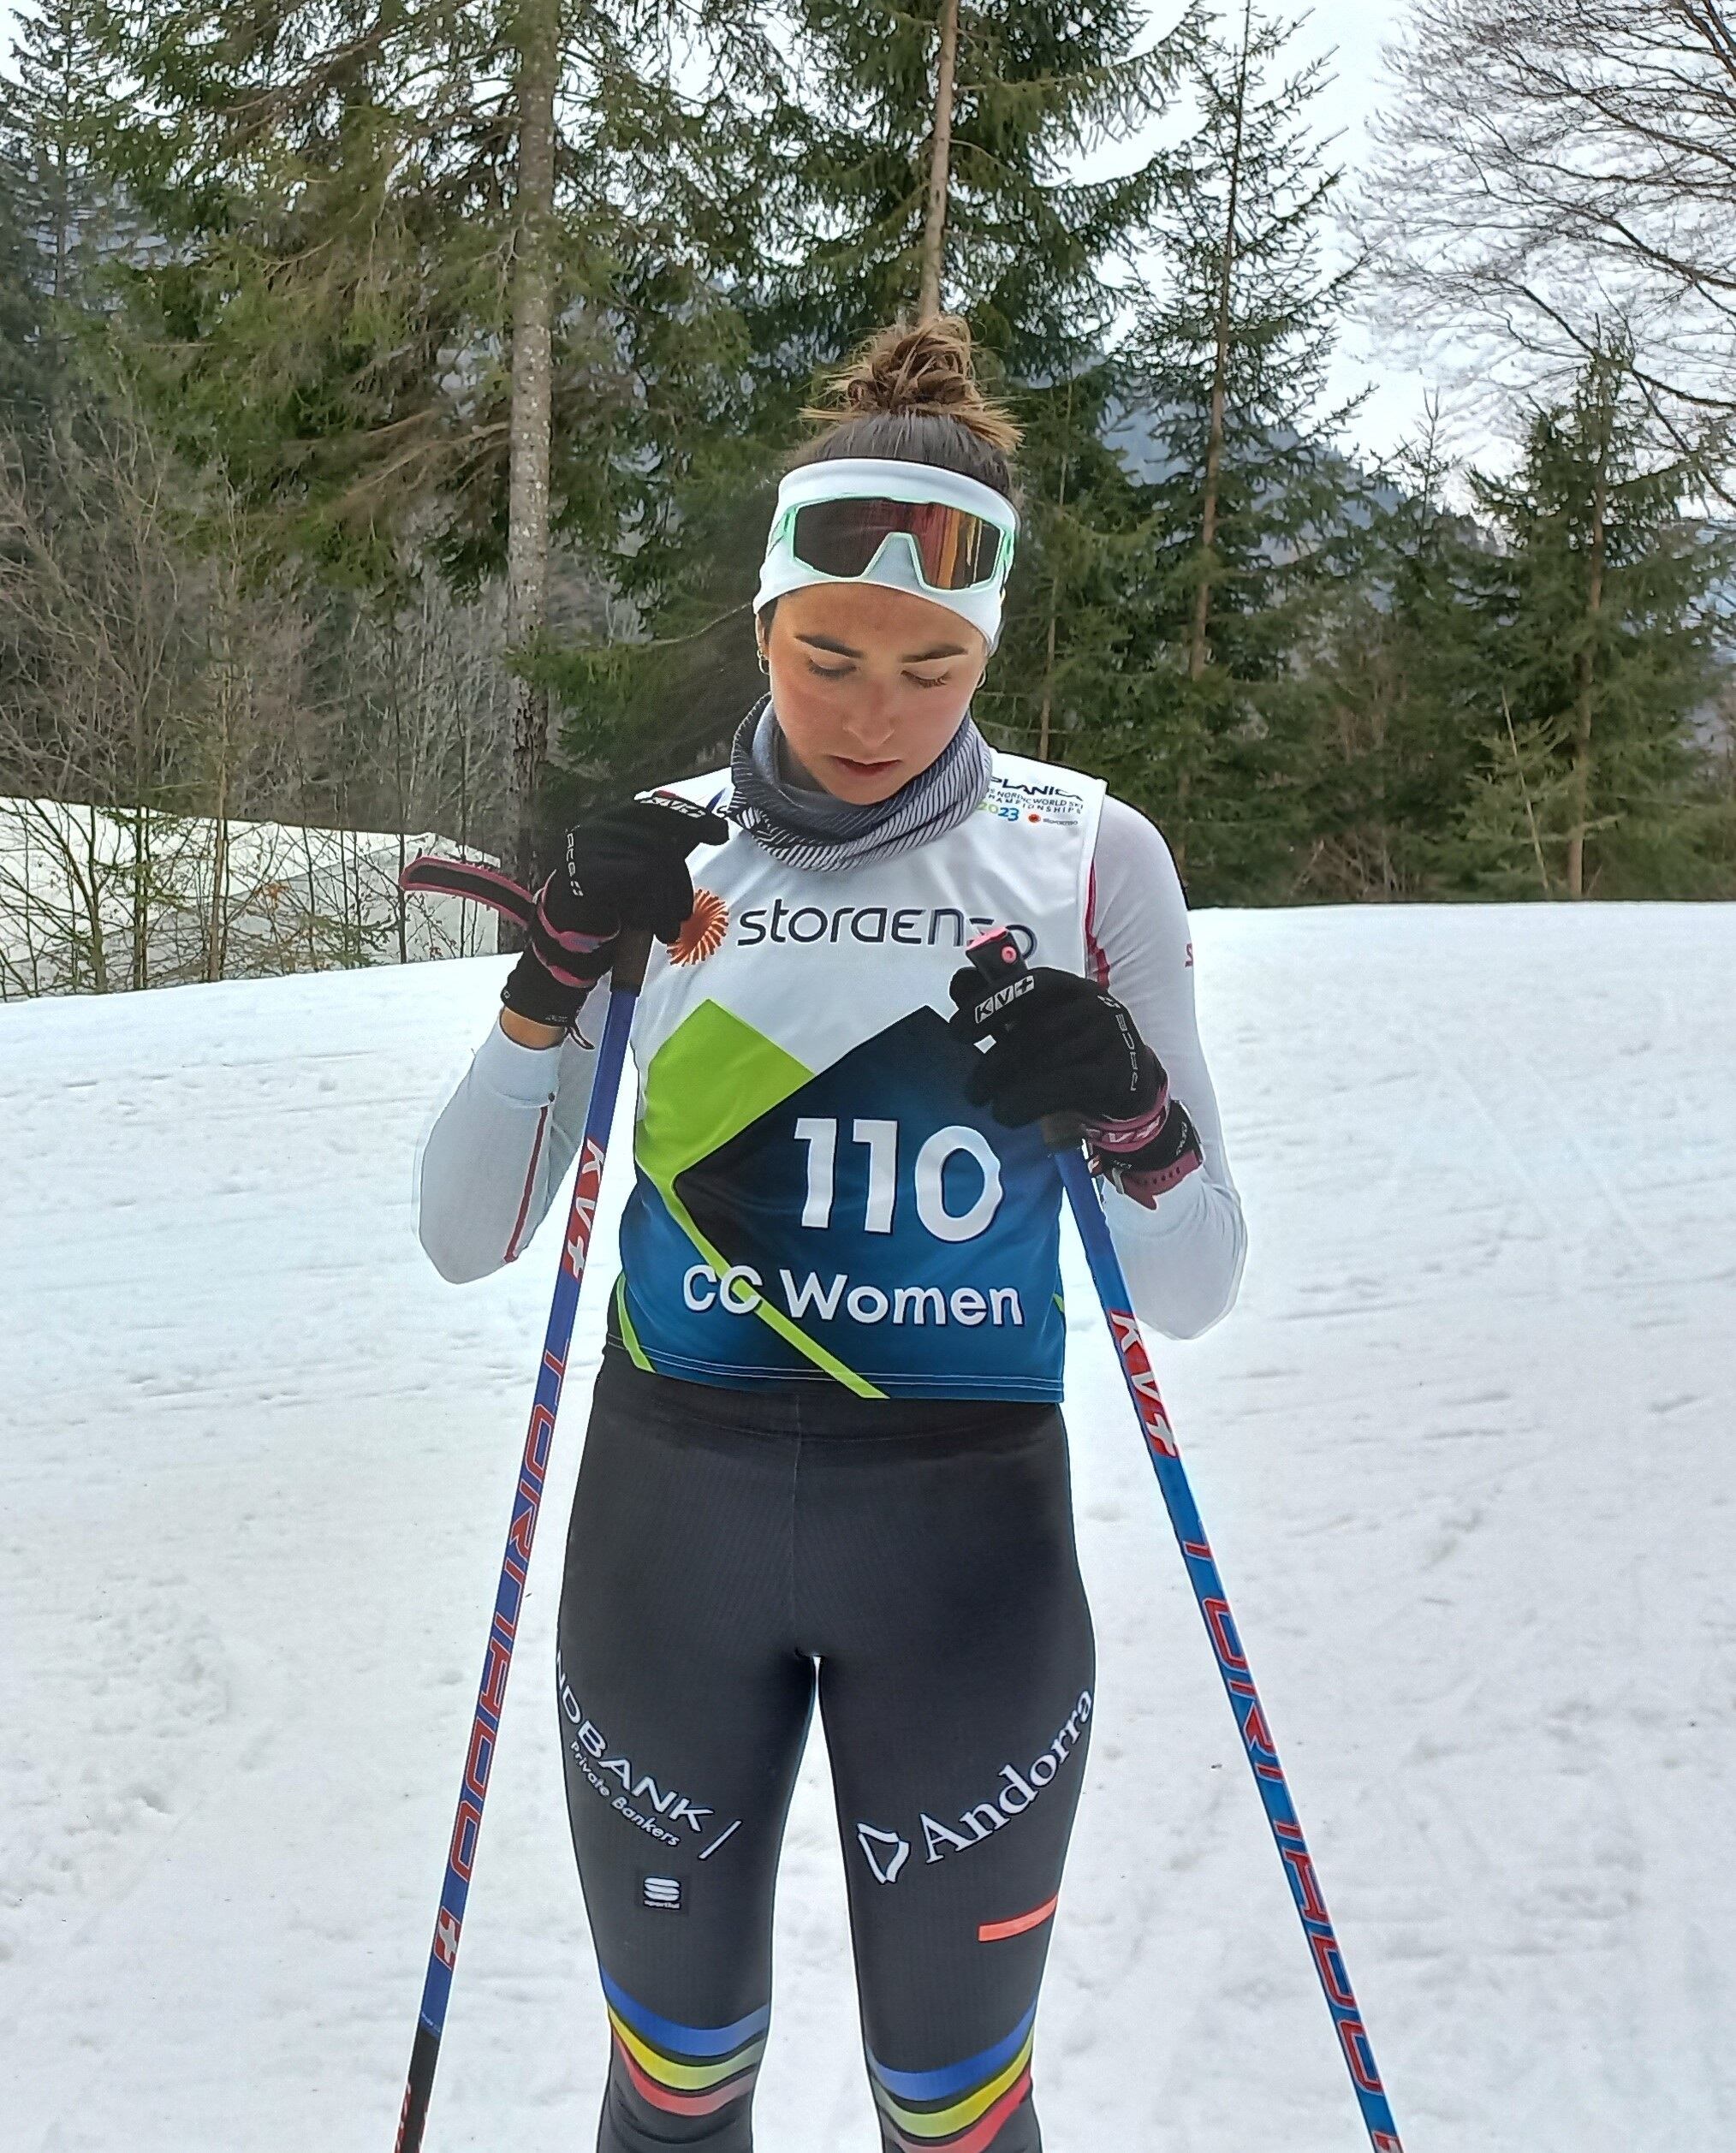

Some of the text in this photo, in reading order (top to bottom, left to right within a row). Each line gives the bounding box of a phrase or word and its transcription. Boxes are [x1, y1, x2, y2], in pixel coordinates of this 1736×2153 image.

[977, 801, 1020, 822] 2023
[987, 794, 1082, 815] HAMPIONSHIPS
[1032, 797, 1067, 808] WORLD
[793, 1117, 1004, 1243] 110
[682, 1264, 1025, 1327] CC Women
[569, 1740, 681, 1848] Private Bankers
[919, 1689, 1093, 1865] Andorra
